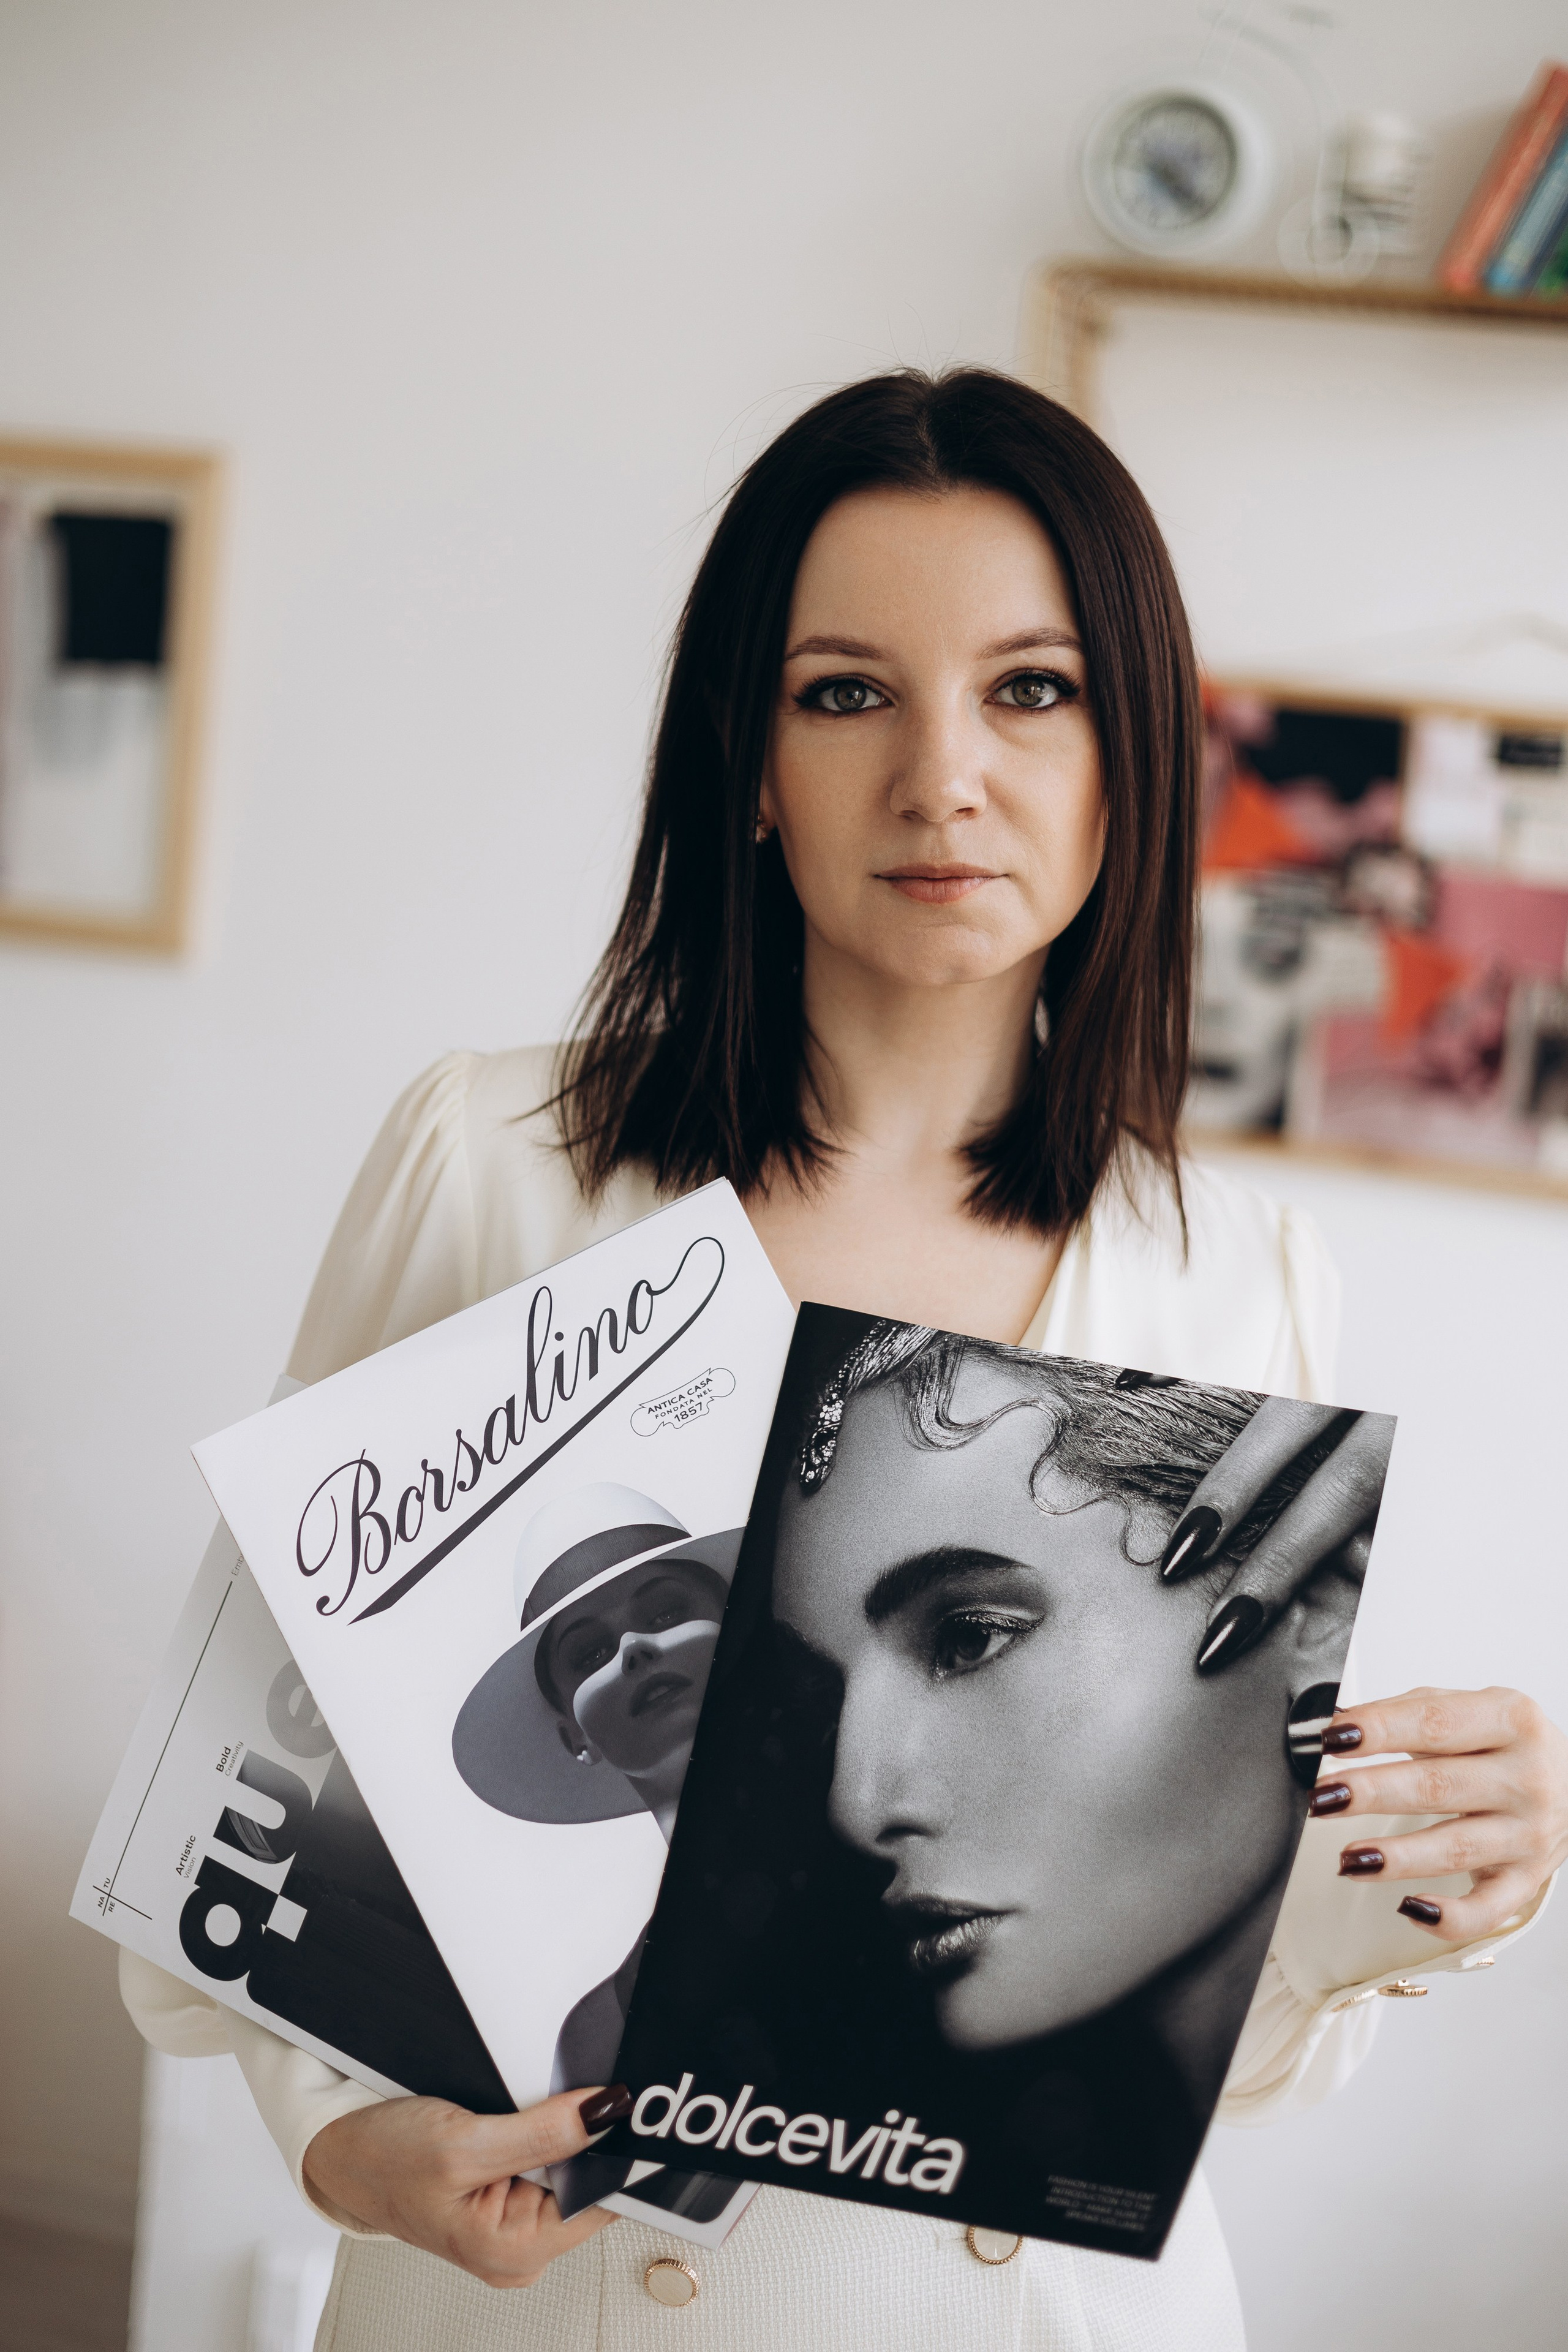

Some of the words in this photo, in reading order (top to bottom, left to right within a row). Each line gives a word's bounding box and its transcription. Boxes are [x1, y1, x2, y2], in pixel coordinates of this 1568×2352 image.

[647, 1393, 685, 1414] ANTICA
[687, 1378, 713, 1396] CASA
[655, 1399, 695, 1419] FONDATA
[697, 1388, 713, 1399] NEL
[674, 1401, 703, 1422] 1857
[296, 1237, 725, 1626] Borsalino
[231, 1553, 244, 1576] Emb
[216, 1746, 232, 1773] Bold
[225, 1741, 244, 1776] Creativity
[176, 1835, 196, 1875] Artistic
[184, 1856, 197, 1879] Vision
[97, 1896, 105, 1909] NA
[103, 1877, 111, 1888] TU
[108, 1901, 116, 1913] RE
[630, 2072, 966, 2195] dolcevita
[1047, 2174, 1087, 2188] FASHION
[1088, 2182, 1097, 2191] IS
[1099, 2185, 1124, 2195] YOUR
[1051, 2185, 1118, 2205] INTRODUCTION
[1121, 2198, 1133, 2208] TO
[1134, 2201, 1152, 2211] THE
